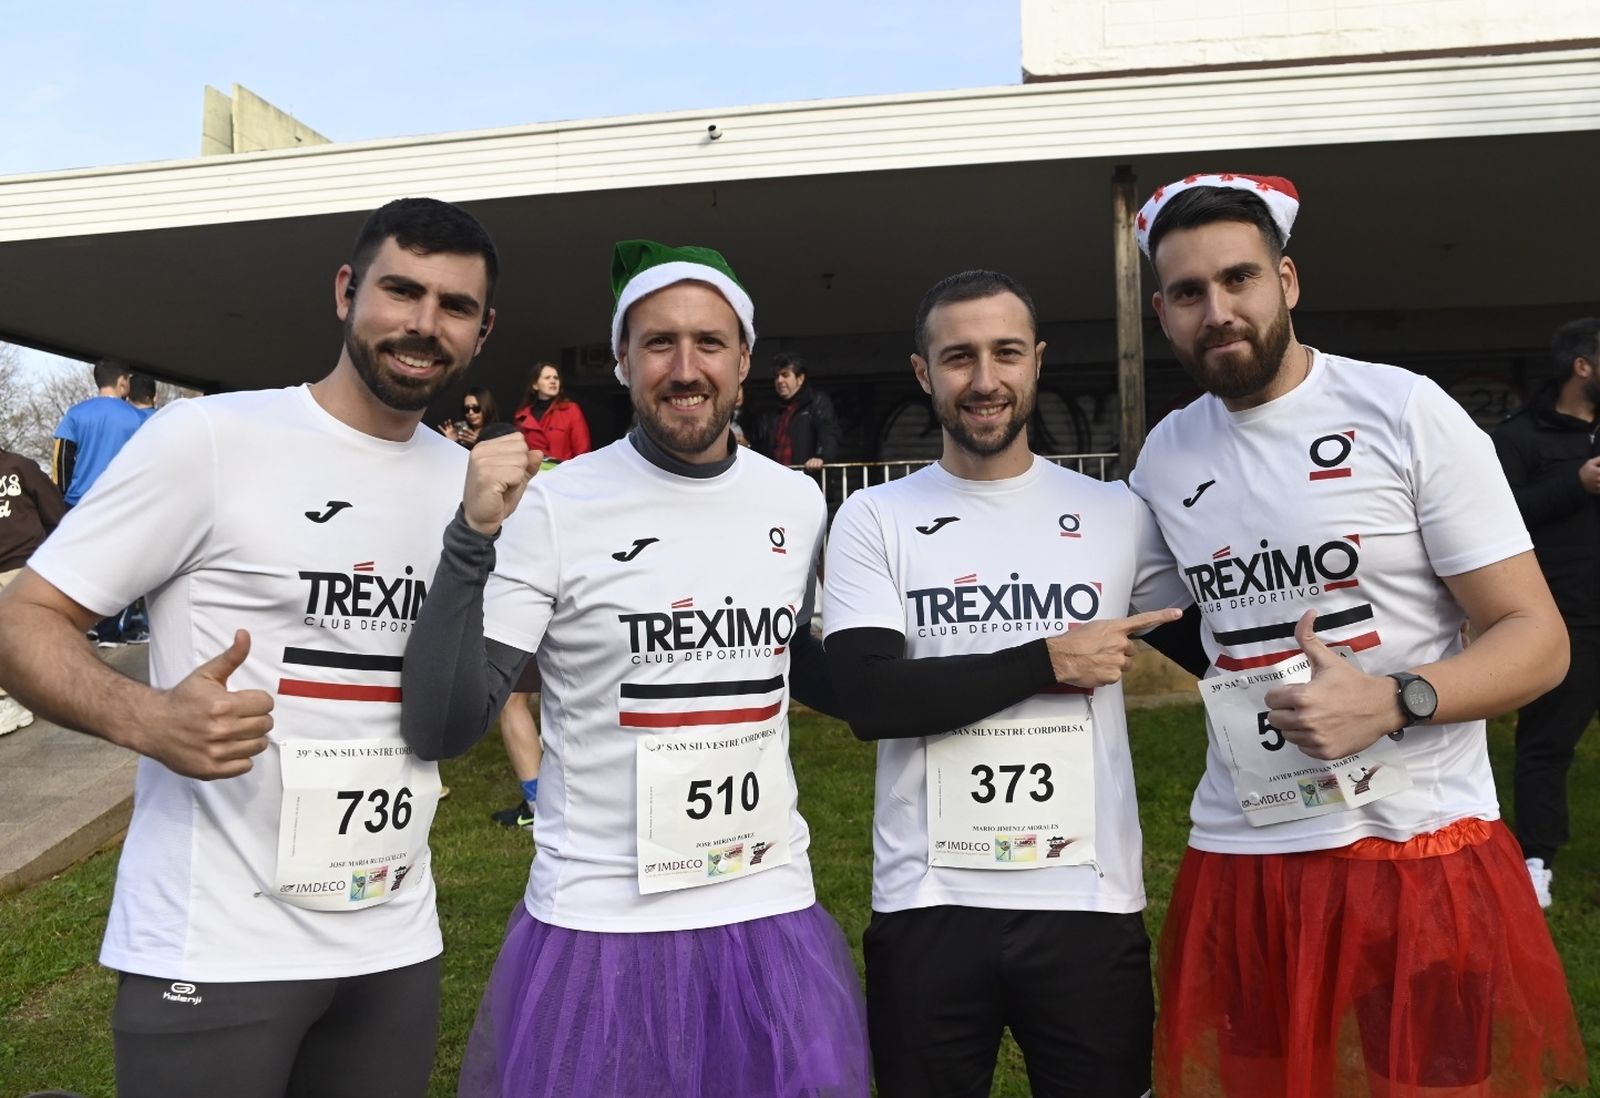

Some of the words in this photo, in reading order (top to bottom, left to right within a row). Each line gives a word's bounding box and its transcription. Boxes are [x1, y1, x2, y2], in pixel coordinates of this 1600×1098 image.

[1230, 585, 1320, 609] DEPORTIVO
[304, 616, 351, 630] CLUB
[361, 619, 415, 633] DEPOR
[917, 626, 958, 638] CLUB
[969, 621, 1064, 634] DEPORTIVO
[631, 653, 675, 665] CLUB
[684, 648, 772, 662] DEPORTIVO
[1246, 670, 1286, 685] ILVESTRE
[952, 728, 970, 736] SAN
[971, 728, 1026, 736] SILVESTRE
[1027, 724, 1084, 735] CORDOBESA
[666, 743, 687, 751] SAN
[689, 738, 740, 750] SILVESTRE
[741, 728, 777, 745] CORDOBESA
[314, 749, 338, 758] SAN
[340, 747, 394, 758] SILVESTRE
[1269, 772, 1293, 783] JAVIER
[1332, 753, 1360, 769] MARTIN
[970, 763, 1055, 804] 373
[686, 771, 760, 820] 510
[1259, 790, 1297, 806] MDECO
[336, 787, 413, 835] 736
[947, 840, 990, 851] IMDECO
[658, 859, 703, 872] IMDECO
[296, 880, 346, 894] IMDECO
